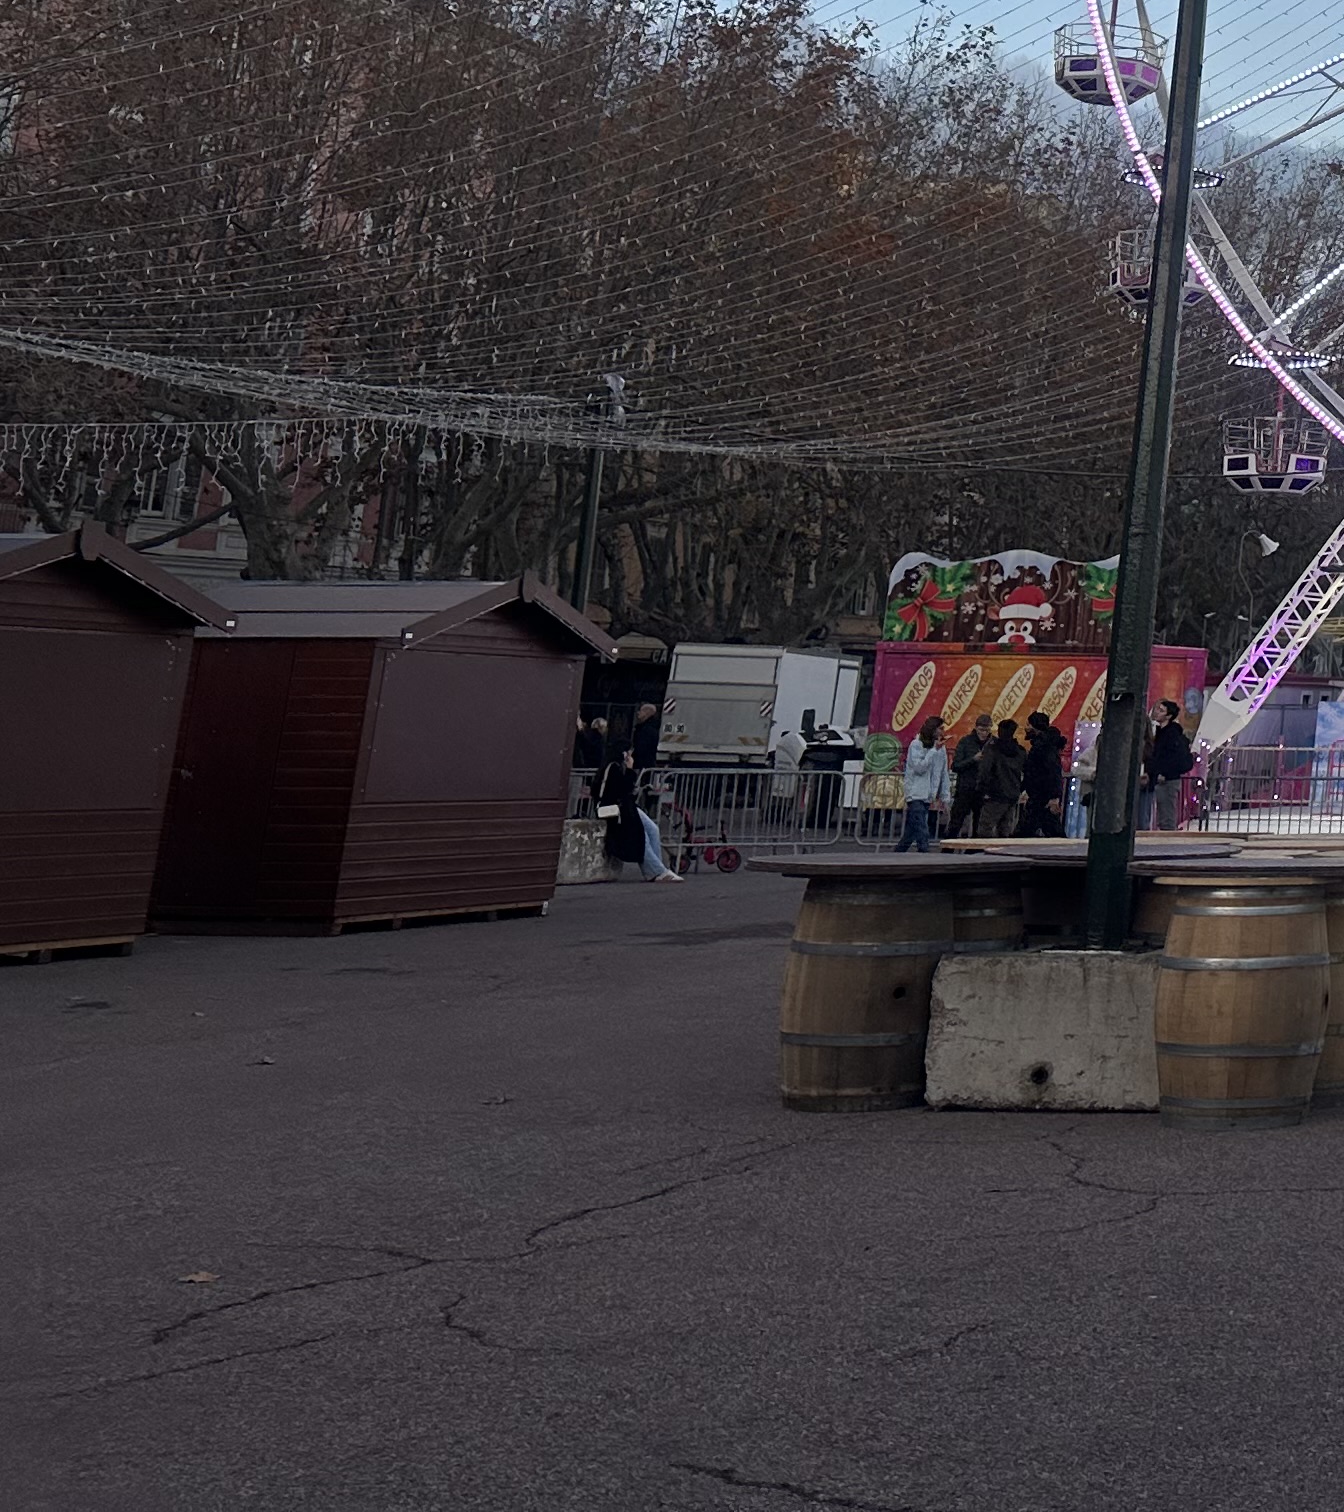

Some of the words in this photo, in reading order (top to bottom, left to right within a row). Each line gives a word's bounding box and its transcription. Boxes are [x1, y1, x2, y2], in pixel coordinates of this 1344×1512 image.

[894, 666, 933, 727] CHURROS
[943, 669, 979, 726] GAUFRES
[1042, 671, 1074, 717] ISSONS
